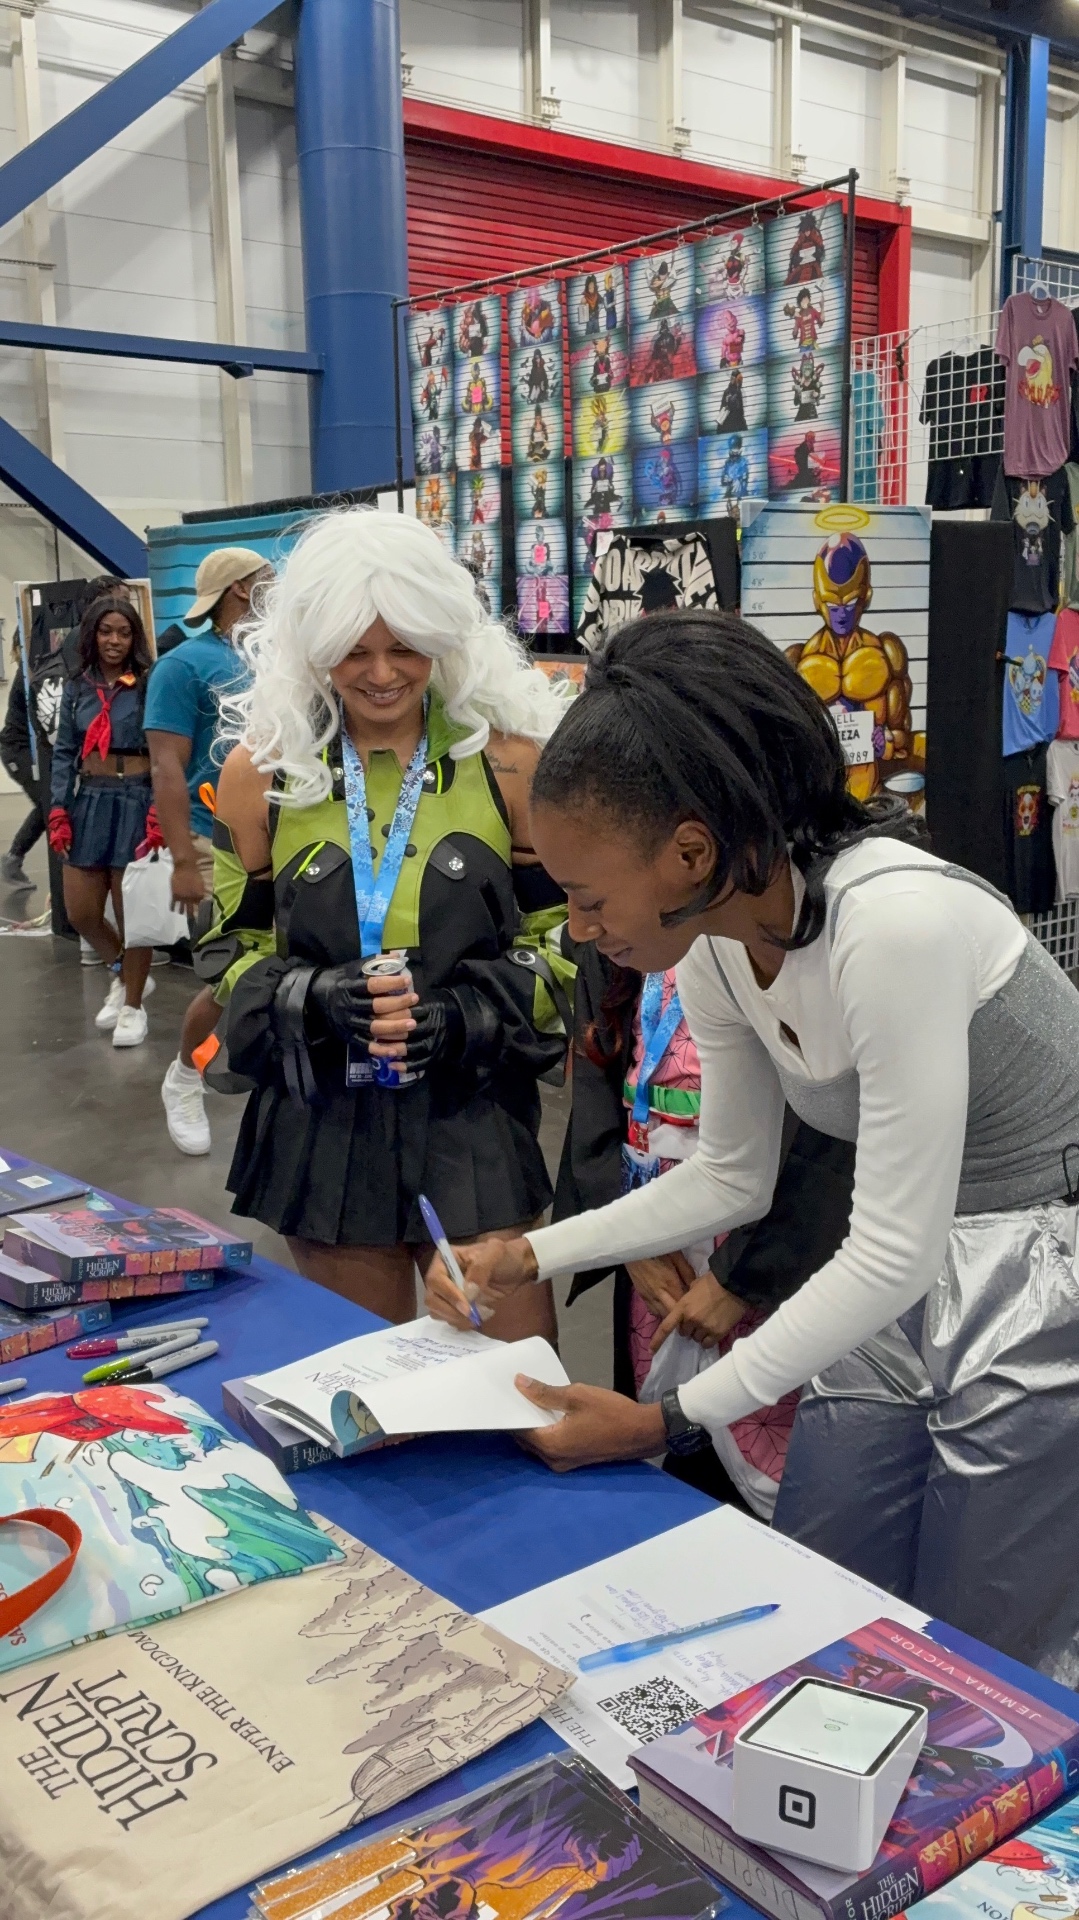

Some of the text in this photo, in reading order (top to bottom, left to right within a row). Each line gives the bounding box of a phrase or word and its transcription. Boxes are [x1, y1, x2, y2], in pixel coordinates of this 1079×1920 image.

[127, 1630, 296, 1774] ENTER THE KINGDOM
[890, 1634, 1042, 1720] JEMIMA VICTOR
[0, 1672, 188, 1832] HIDDEN
[72, 1669, 218, 1783] SCRIPT
[566, 1719, 597, 1748] THE
[17, 1745, 79, 1801] THE
[702, 1826, 799, 1920] DISPLAY
[860, 1866, 919, 1920] HIDDEN
[877, 1872, 897, 1892] THE
